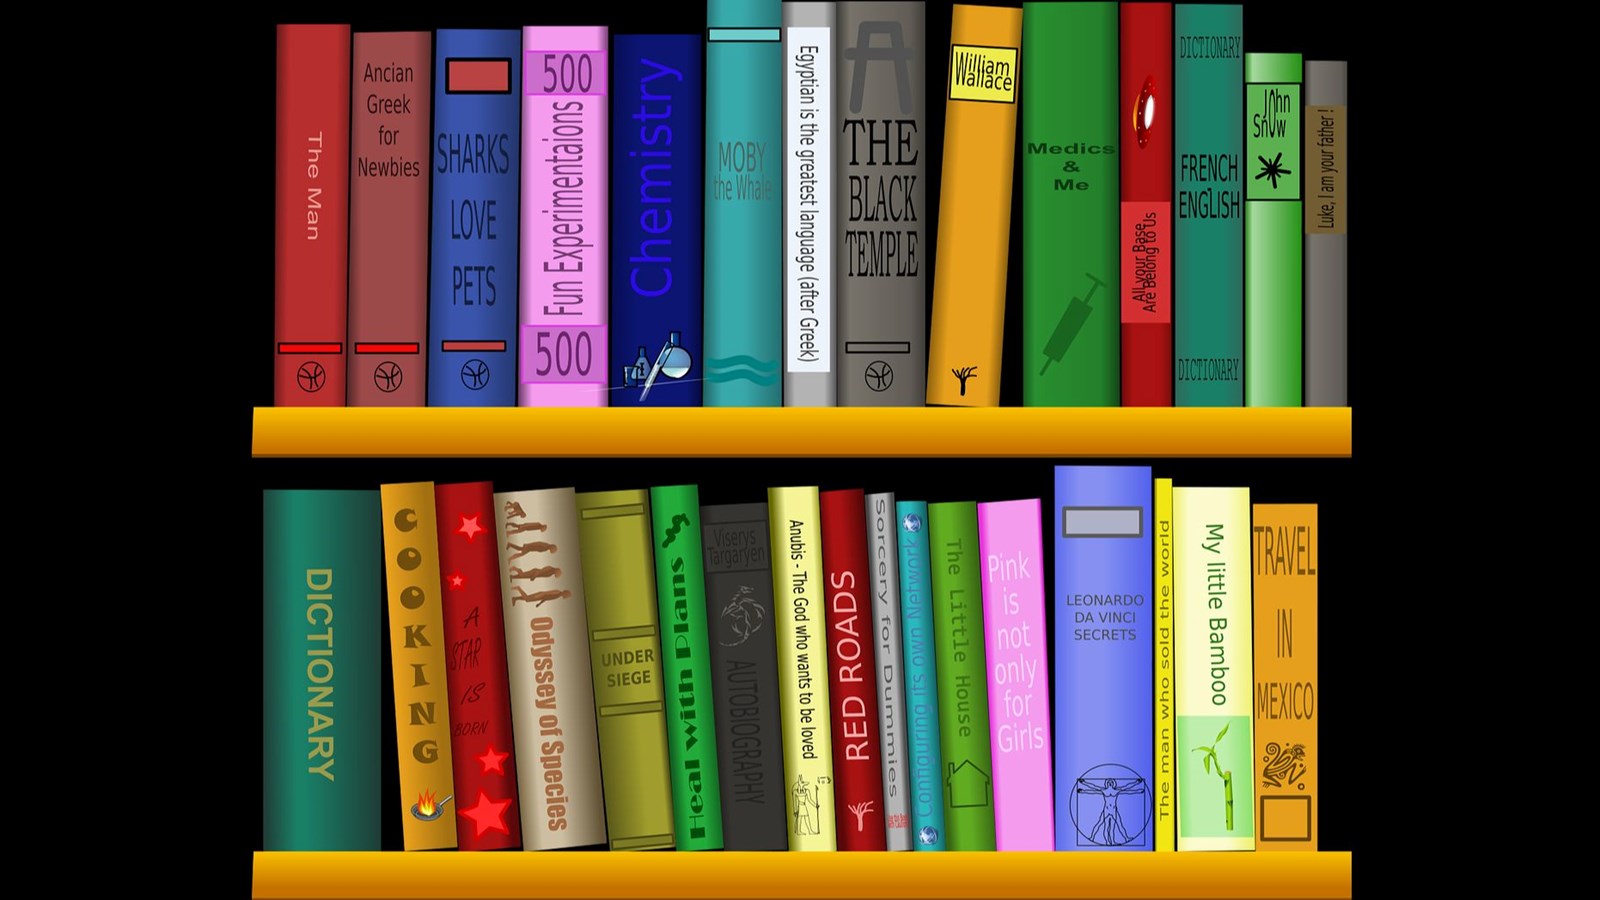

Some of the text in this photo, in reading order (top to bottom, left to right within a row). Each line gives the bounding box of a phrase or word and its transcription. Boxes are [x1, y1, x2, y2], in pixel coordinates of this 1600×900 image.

[1180, 36, 1241, 59] DICTIONARY
[363, 63, 413, 83] Ancian
[543, 53, 592, 93] 500
[955, 51, 1010, 82] William
[955, 51, 1013, 92] Wallace
[366, 94, 411, 114] Greek
[378, 125, 399, 146] for
[843, 119, 918, 165] THE
[1316, 115, 1335, 147] father
[437, 133, 509, 174] SHARKS
[718, 141, 766, 172] MOBY
[1027, 142, 1116, 155] Medics
[1321, 149, 1338, 173] your
[358, 157, 420, 177] Newbies
[629, 57, 682, 297] Chemistry
[1062, 160, 1080, 173] &
[1182, 154, 1238, 182] FRENCH
[306, 132, 322, 240] The Man
[714, 175, 773, 201] the Whale
[848, 175, 917, 222] BLACK
[1054, 179, 1089, 191] Me
[1321, 173, 1335, 193] am
[542, 101, 593, 315] Fun Experimentaions
[795, 46, 820, 362] Egyptian is the greatest language (after Greek)
[1179, 188, 1239, 219] ENGLISH
[1317, 201, 1336, 229] Luke,
[451, 200, 496, 240] LOVE
[846, 230, 918, 278] TEMPLE
[1131, 223, 1150, 302] All your Base
[1142, 212, 1160, 313] Are Belong to Us
[453, 265, 496, 306] PETS
[535, 332, 592, 376] 500
[1178, 358, 1239, 381] DICTIONARY
[713, 529, 756, 547] Viserys
[789, 519, 806, 560] Anubis
[1254, 526, 1315, 576] TRAVEL
[707, 542, 765, 568] Targaryen
[988, 551, 1030, 583] Pink
[792, 571, 808, 594] The
[903, 538, 922, 620] Network
[794, 597, 811, 622] God
[1003, 588, 1019, 616] is
[1067, 594, 1144, 606] LEONARDO
[1201, 524, 1230, 706] My little Bamboo
[1075, 612, 1136, 623] DA VINCI
[1277, 609, 1292, 658] IN
[393, 508, 439, 764] COOKING
[796, 625, 811, 650] who
[875, 498, 898, 797] Sorcery for Dummies
[910, 627, 927, 667] own
[945, 538, 972, 738] The Little House
[998, 620, 1030, 648] not
[1074, 629, 1136, 641] SECRETS
[450, 640, 481, 672] STAR
[601, 649, 654, 667] UNDER
[798, 654, 813, 689] wants
[830, 570, 870, 761] RED ROADS
[994, 654, 1036, 689] only
[1159, 520, 1170, 822] The man who sold the world
[306, 569, 335, 782] DICTIONARY
[607, 670, 651, 688] SIEGE
[460, 683, 484, 705] IS
[671, 557, 706, 840] Heal with Plans
[799, 693, 814, 705] to
[1003, 689, 1032, 717] for
[1258, 682, 1313, 720] MEXICO
[454, 721, 488, 737] BORN
[530, 617, 568, 832] Odyssey of Species
[726, 659, 766, 805] AUTOBIOGRAPHY
[800, 709, 816, 723] be
[801, 727, 818, 760] loved
[998, 721, 1044, 752] Girls
[911, 703, 934, 818] Configuring
